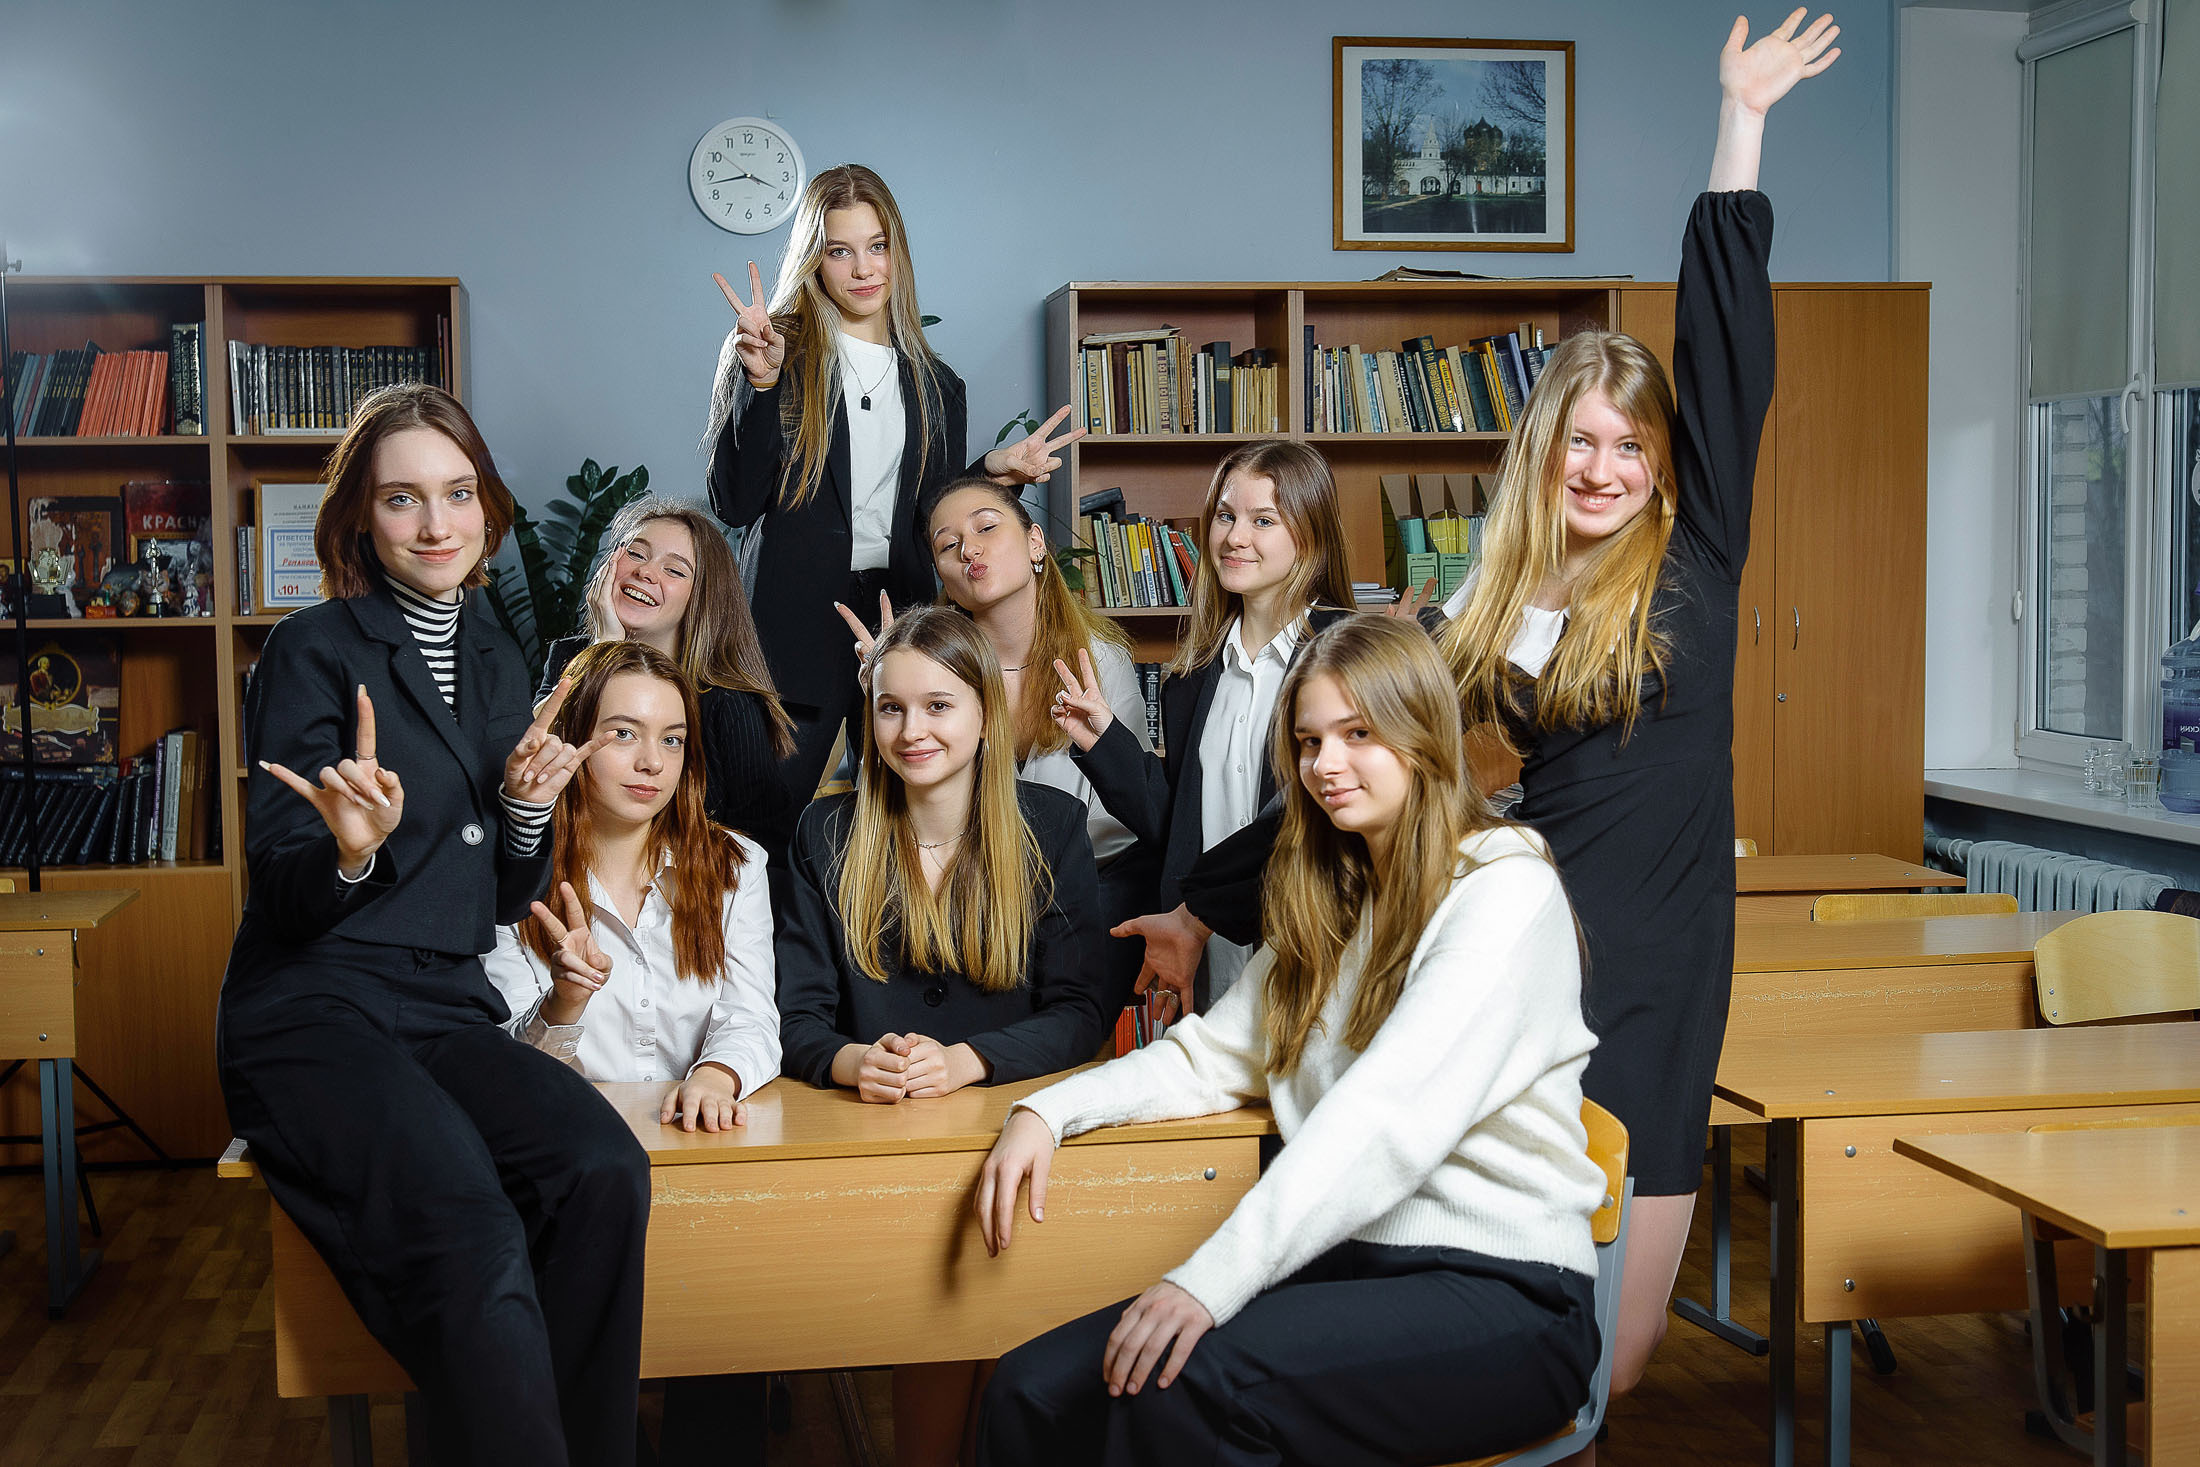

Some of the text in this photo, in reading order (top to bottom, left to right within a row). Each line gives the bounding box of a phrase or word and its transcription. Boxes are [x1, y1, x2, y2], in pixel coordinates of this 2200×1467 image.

[726, 137, 734, 149] 11
[743, 133, 754, 144] 12
[765, 138, 770, 149] 1
[711, 152, 722, 163] 10
[777, 153, 784, 163] 2
[707, 170, 715, 180] 9
[782, 171, 790, 182] 3
[712, 189, 720, 200] 8
[777, 191, 785, 201] 4
[725, 203, 734, 216] 7
[744, 208, 753, 220] 6
[763, 204, 771, 215] 5
[143, 514, 203, 531] КРАСН
[282, 583, 299, 595] 101
[1147, 572, 1155, 600] РУССКИЙ
